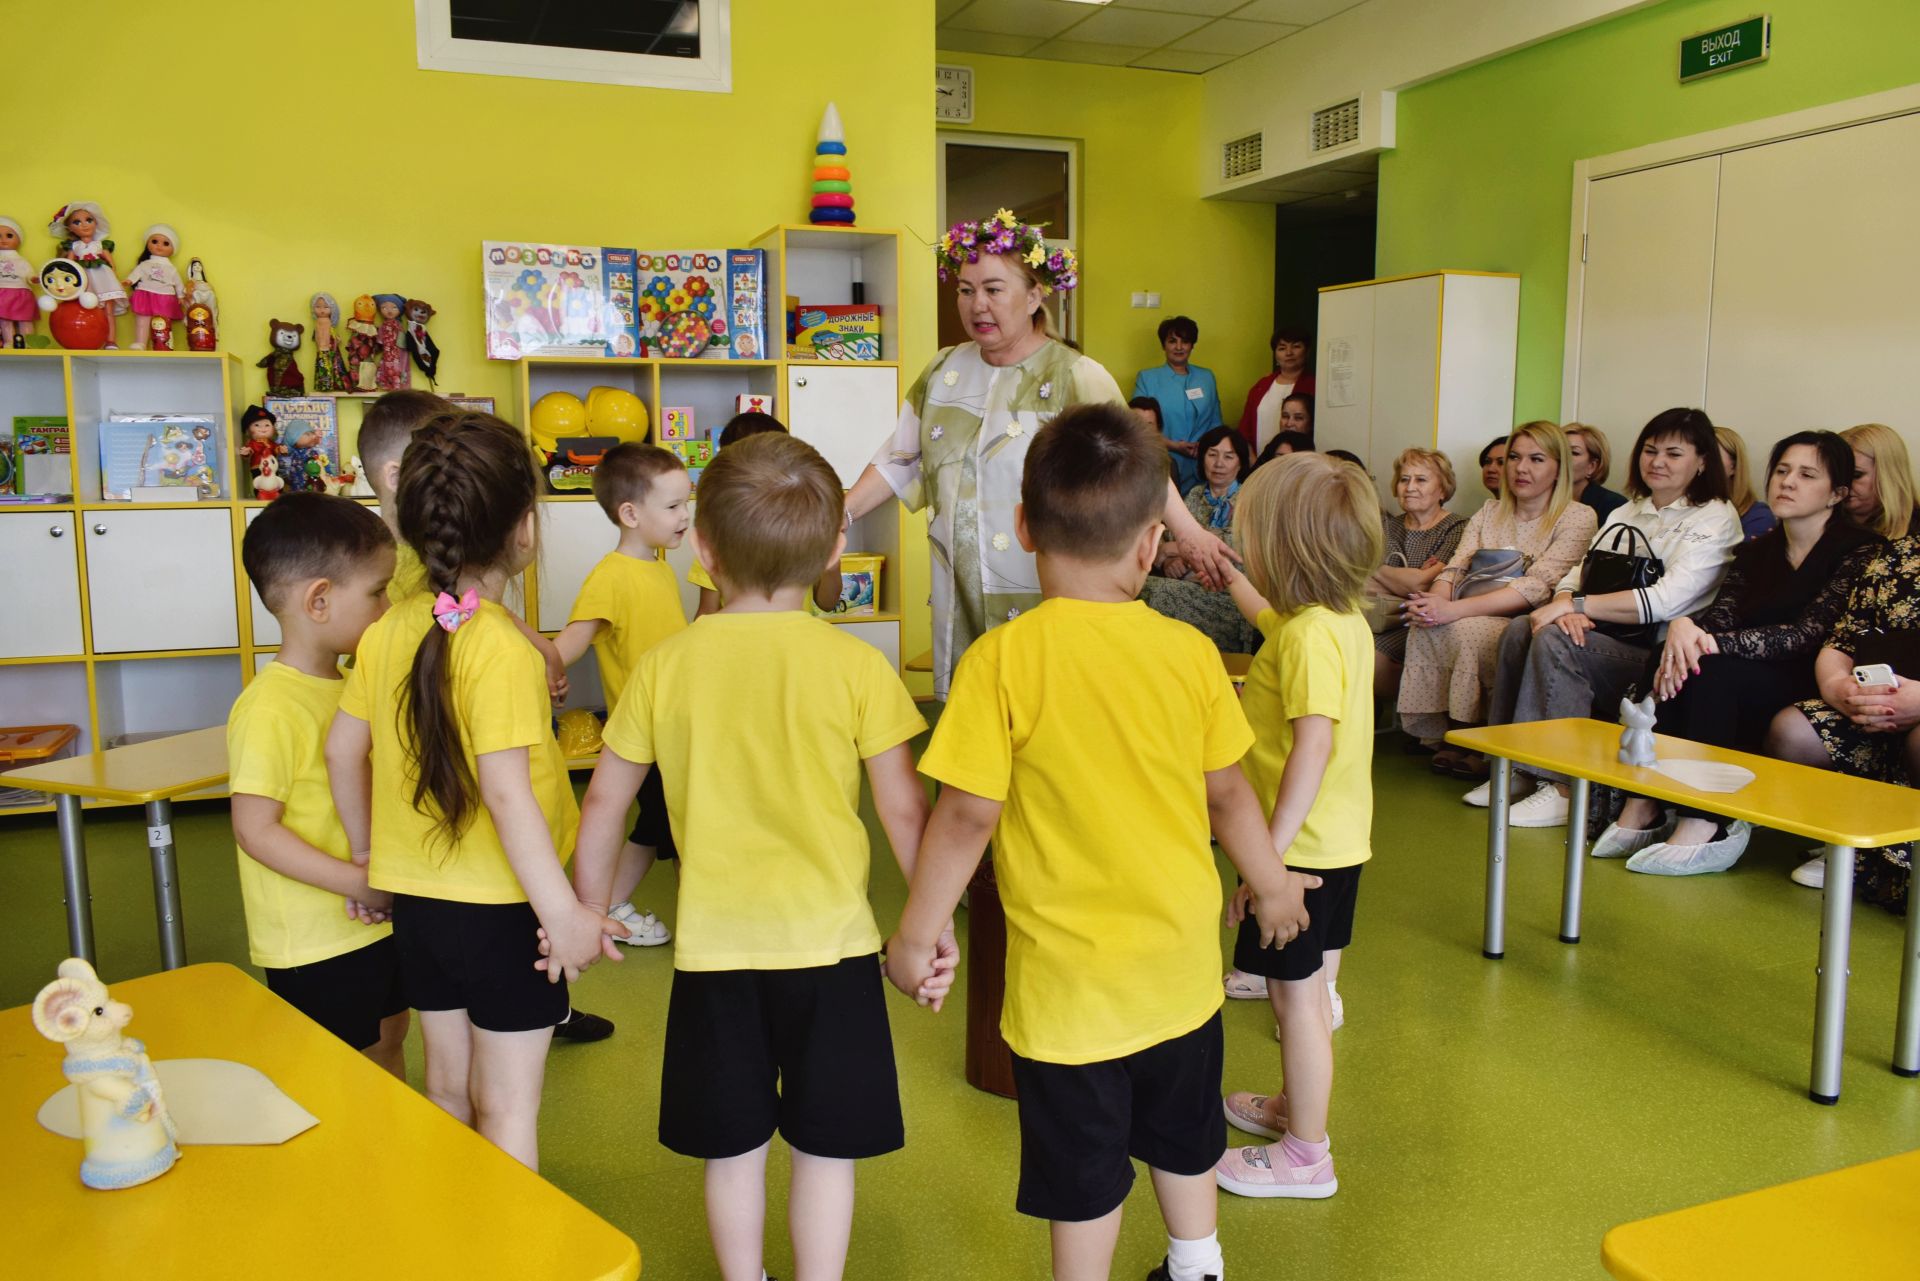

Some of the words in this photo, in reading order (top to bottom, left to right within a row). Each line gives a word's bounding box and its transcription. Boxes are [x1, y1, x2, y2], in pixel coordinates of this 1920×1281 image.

[1701, 29, 1741, 54] ВЫХОД
[1709, 49, 1733, 66] EXIT
[828, 312, 874, 324] ДОРОЖНЫЕ
[838, 325, 864, 333] ЗНАКИ
[562, 466, 594, 478] СТРО
[154, 830, 162, 841] 2
